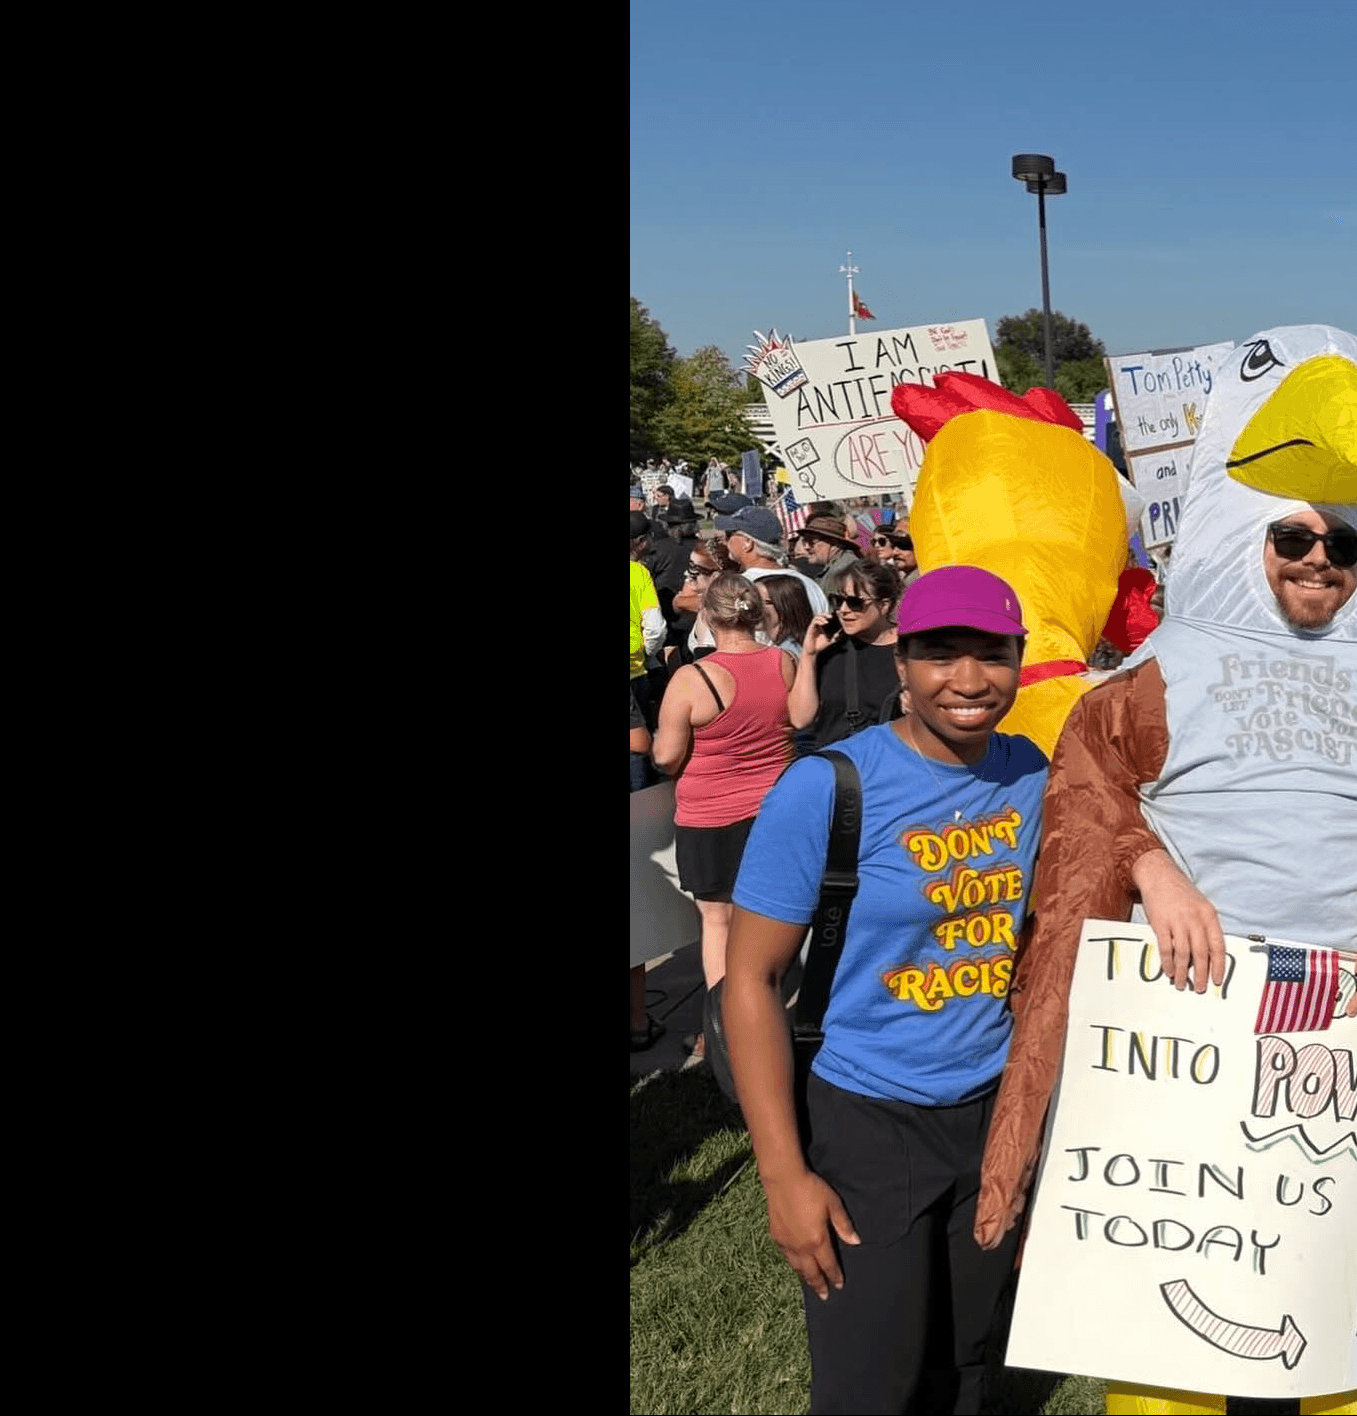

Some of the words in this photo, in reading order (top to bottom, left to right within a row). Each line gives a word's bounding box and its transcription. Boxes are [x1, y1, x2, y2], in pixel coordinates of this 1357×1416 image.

[763, 353, 779, 367] NO
[835, 341, 866, 373] I
[875, 332, 920, 369] AM
[1120, 365, 1172, 396] Tom
[1138, 415, 1157, 436] the
[1159, 411, 1180, 439] only
[848, 432, 898, 480] ARE
[1156, 460, 1178, 480] and
[1206, 650, 1352, 695] Friends
[1222, 699, 1249, 713] LET
[1235, 705, 1299, 732] Vote
[904, 809, 1022, 873] DON'T
[925, 865, 1023, 914] VOTE
[934, 908, 1019, 951] FOR
[882, 955, 1014, 1012] RACIS
[1088, 936, 1237, 1000] TU
[1090, 1025, 1221, 1085] INTO
[1064, 1146, 1245, 1202] JOIN
[1274, 1172, 1337, 1216] US
[1060, 1204, 1282, 1276] TODAY
